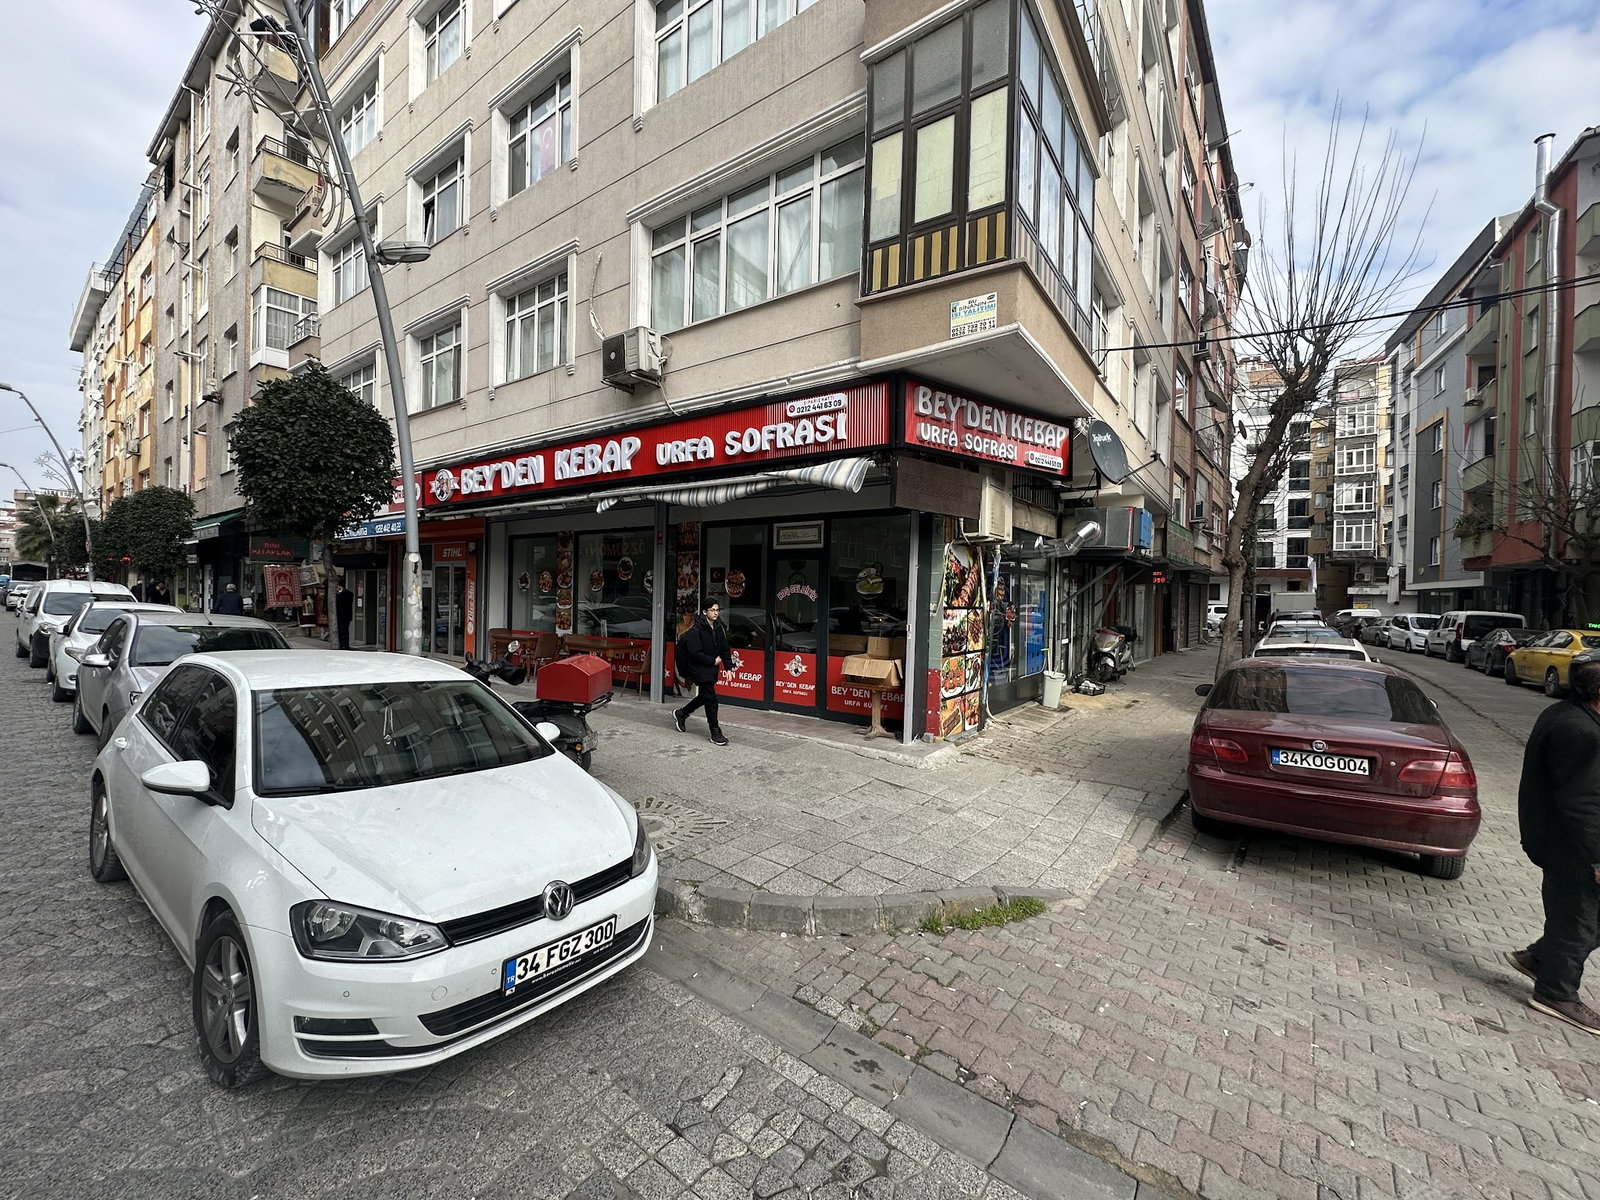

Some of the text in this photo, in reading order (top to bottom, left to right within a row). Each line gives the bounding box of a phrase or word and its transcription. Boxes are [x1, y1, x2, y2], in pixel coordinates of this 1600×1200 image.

[797, 405, 811, 413] 0212
[812, 402, 823, 411] 441
[916, 386, 1067, 449] BEY'DEN KEBAP
[918, 422, 1018, 460] URFA SOFRASI
[460, 413, 848, 494] BEY'DEN KEBAP URFA SOFRASI
[443, 548, 462, 558] STIHL
[730, 681, 751, 689] SOFRASI
[739, 672, 762, 682] KEBAP
[1280, 751, 1367, 773] 34KOG004
[506, 975, 515, 984] TR
[517, 952, 540, 979] 34
[546, 934, 582, 968] FGZ
[585, 921, 613, 949] 300
